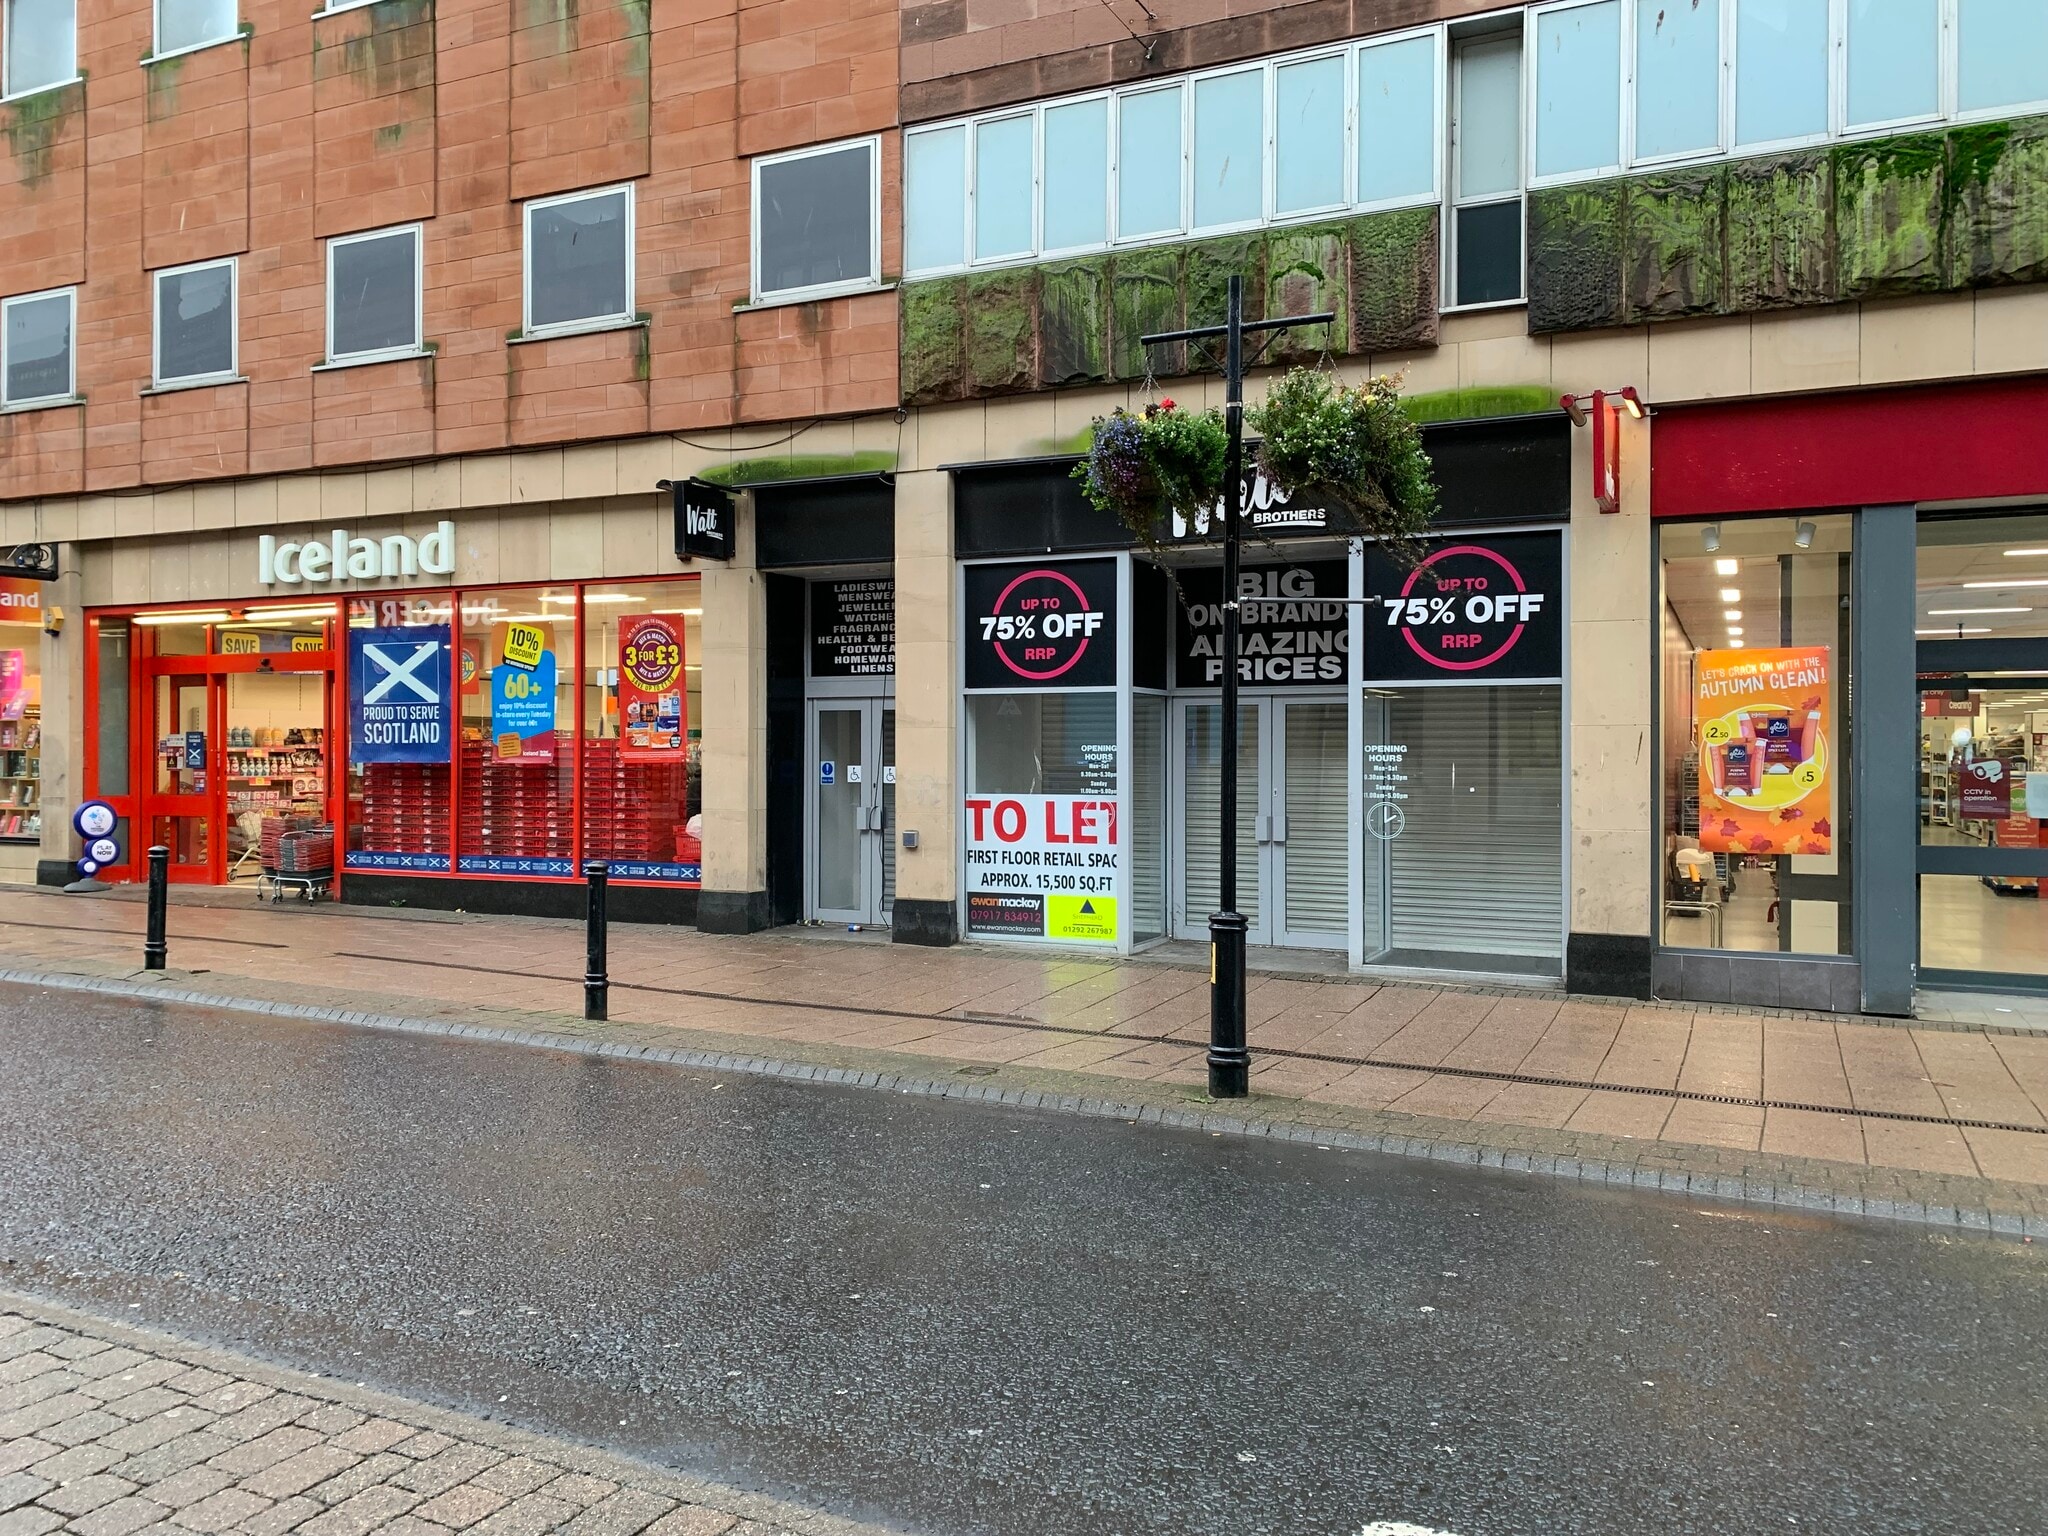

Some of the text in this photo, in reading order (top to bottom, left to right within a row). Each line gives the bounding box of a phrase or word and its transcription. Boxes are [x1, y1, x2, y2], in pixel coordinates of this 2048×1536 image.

[687, 504, 717, 535] Watt
[1253, 508, 1326, 524] BROTHERS
[259, 521, 455, 584] Iceland
[1238, 569, 1315, 598] BIG
[1438, 577, 1488, 591] UP TO
[1021, 598, 1060, 610] UP TO
[1384, 594, 1544, 625] 75% OFF
[844, 613, 895, 622] WATCHE
[1190, 603, 1348, 627] ON BRAND
[980, 612, 1103, 640] 75% OFF
[226, 638, 256, 653] SAVE
[511, 628, 539, 652] 10%
[818, 635, 861, 644] HEALTH
[1442, 634, 1482, 648] RRP
[509, 646, 537, 660] DISCOUNT
[626, 645, 679, 666] 3 FOR £3
[1025, 648, 1056, 660] RRP
[851, 664, 894, 673] LINENS
[1206, 655, 1342, 681] PRICES
[1702, 657, 1820, 680] LET'S CRACK ON WITH THE
[505, 673, 542, 699] 60+
[1700, 668, 1826, 699] AUTUMN CLEAN!
[363, 706, 440, 720] PROUD TO SERVE
[1949, 701, 1972, 711] cleaning
[531, 711, 551, 719] Tuesday
[364, 722, 440, 744] SCOTLAND
[1369, 754, 1402, 762] HOURS
[1802, 771, 1815, 782] £5
[966, 800, 1117, 845] TO LET
[967, 850, 998, 864] FIRST
[1002, 851, 1040, 865] FLOOR
[1044, 852, 1084, 867] RETAIL
[981, 872, 1112, 893] APPROX. 15,500 SQ.FT
[971, 897, 1040, 910] ewanmackay
[971, 910, 1041, 922] 07917 834912
[972, 924, 1041, 933] www.ewanmackay.com
